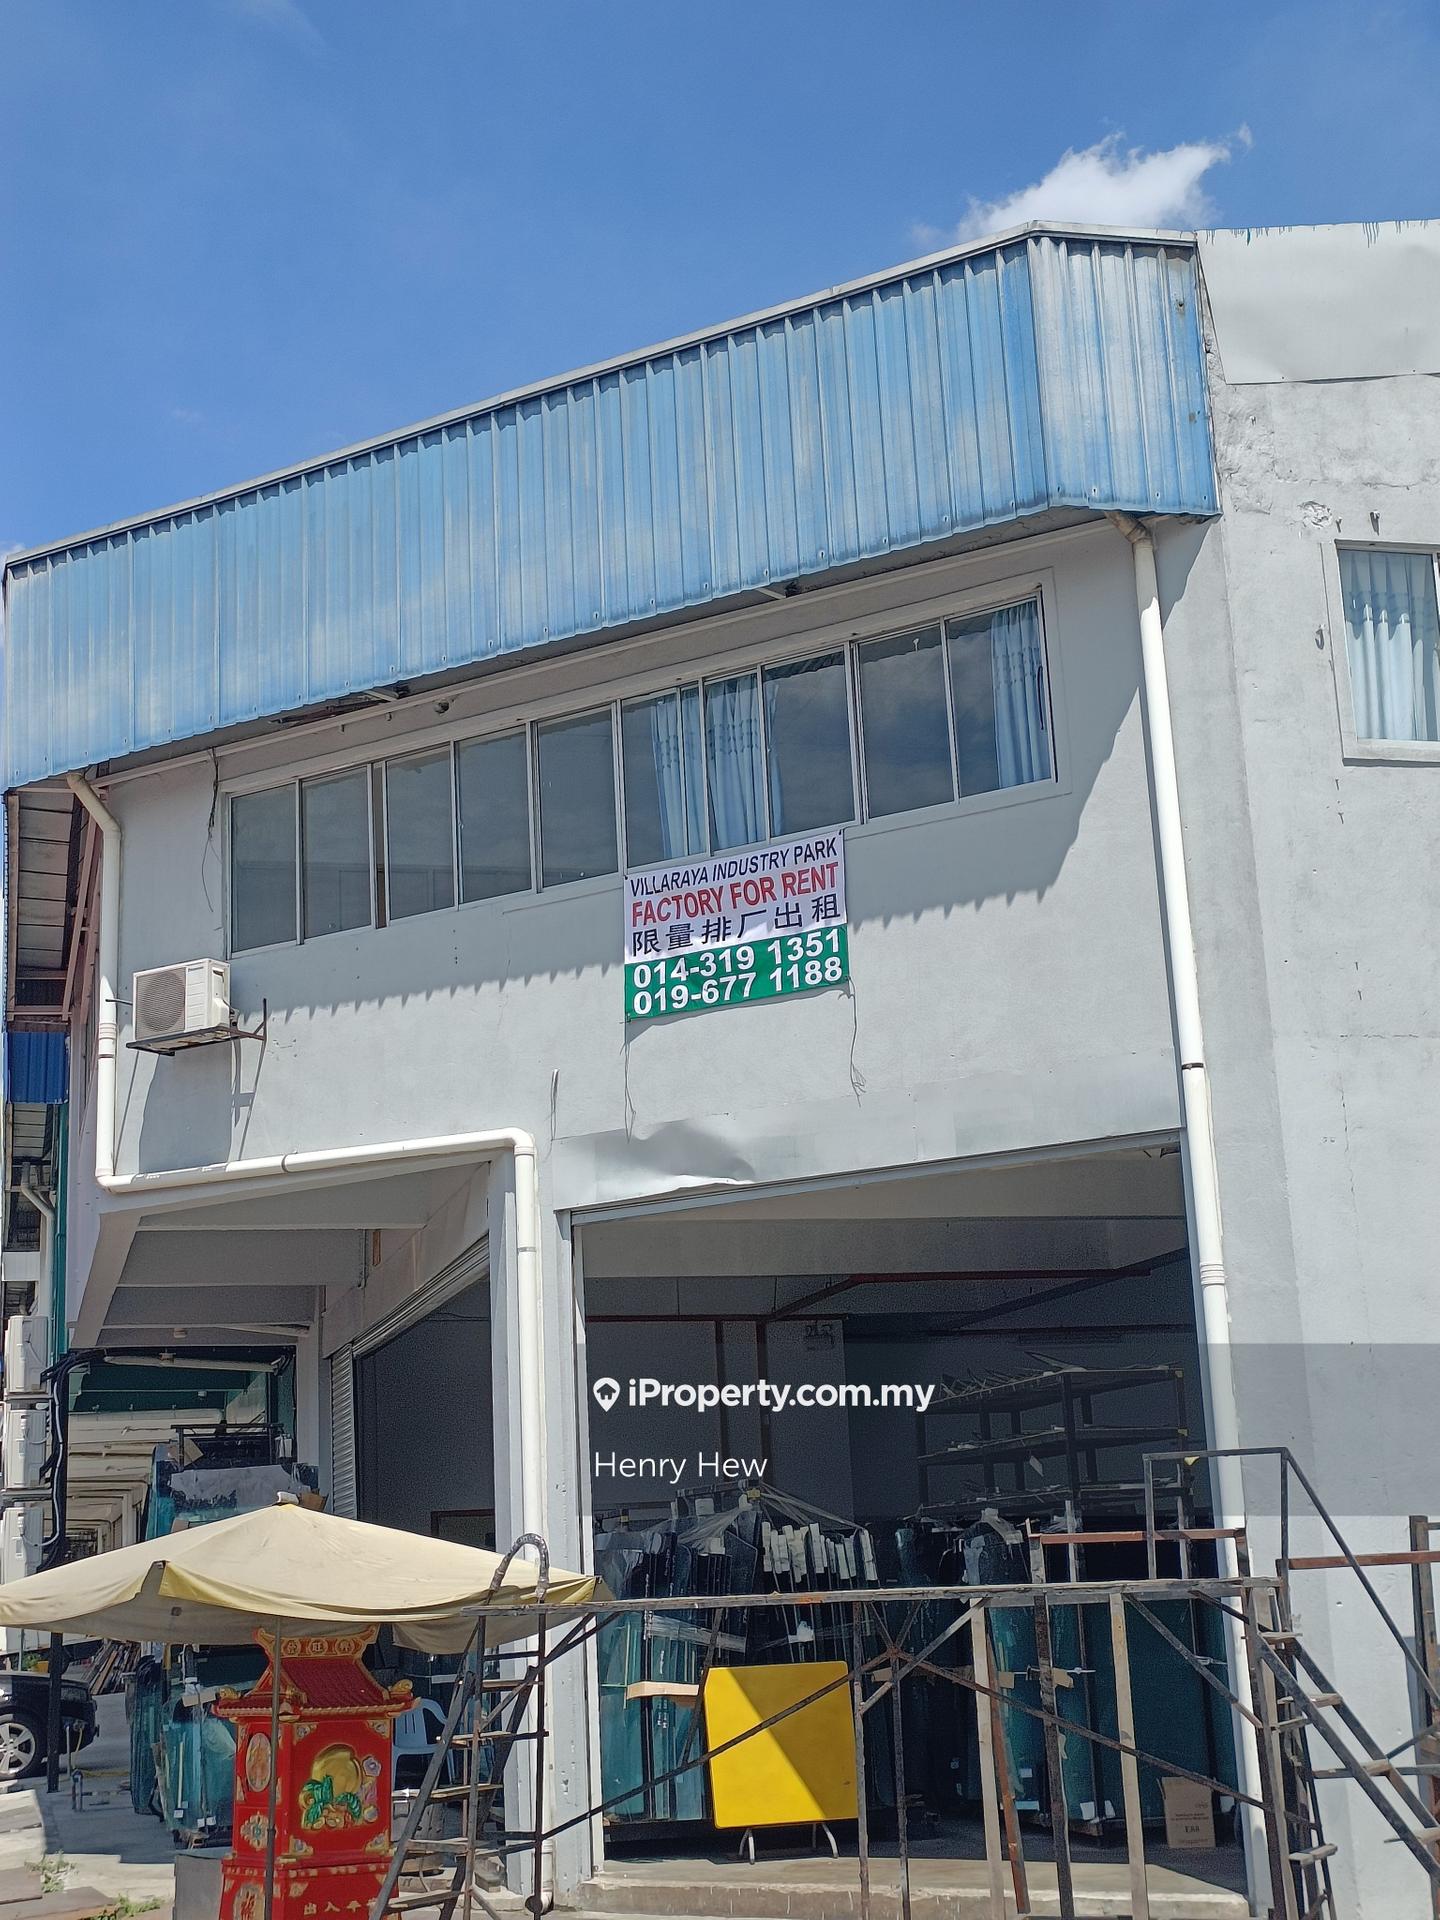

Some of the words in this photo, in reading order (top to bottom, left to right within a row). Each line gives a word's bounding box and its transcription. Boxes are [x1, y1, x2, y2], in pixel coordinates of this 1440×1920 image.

[630, 867, 709, 897] VILLARAYA
[712, 849, 790, 882] INDUSTRY
[793, 837, 838, 865] PARK
[632, 885, 724, 927] FACTORY
[729, 876, 777, 909] FOR
[781, 862, 839, 898] RENT
[632, 893, 841, 957] 限量排厂出租
[633, 945, 755, 988] 014-319
[768, 928, 840, 965] 1351
[633, 972, 757, 1014] 019-677
[769, 956, 843, 991] 1188
